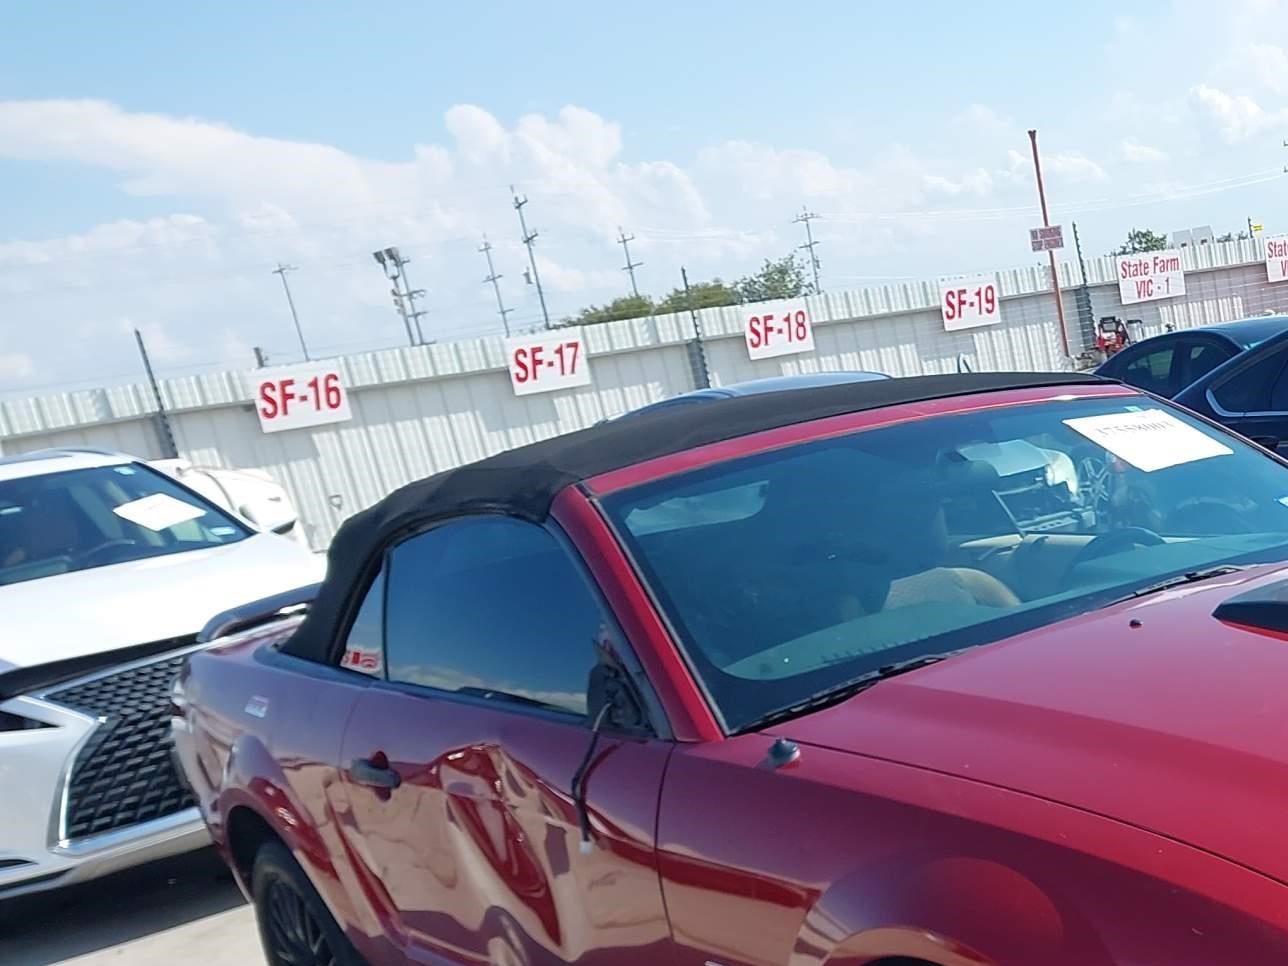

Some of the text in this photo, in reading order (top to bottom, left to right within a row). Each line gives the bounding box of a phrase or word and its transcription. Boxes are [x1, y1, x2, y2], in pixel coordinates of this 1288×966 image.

[1120, 256, 1180, 279] State Farm
[944, 284, 996, 321] SF-19
[1135, 278, 1154, 299] VIC
[1164, 276, 1170, 294] 1
[748, 310, 807, 349] SF-18
[513, 341, 580, 384] SF-17
[259, 373, 342, 420] SF-16
